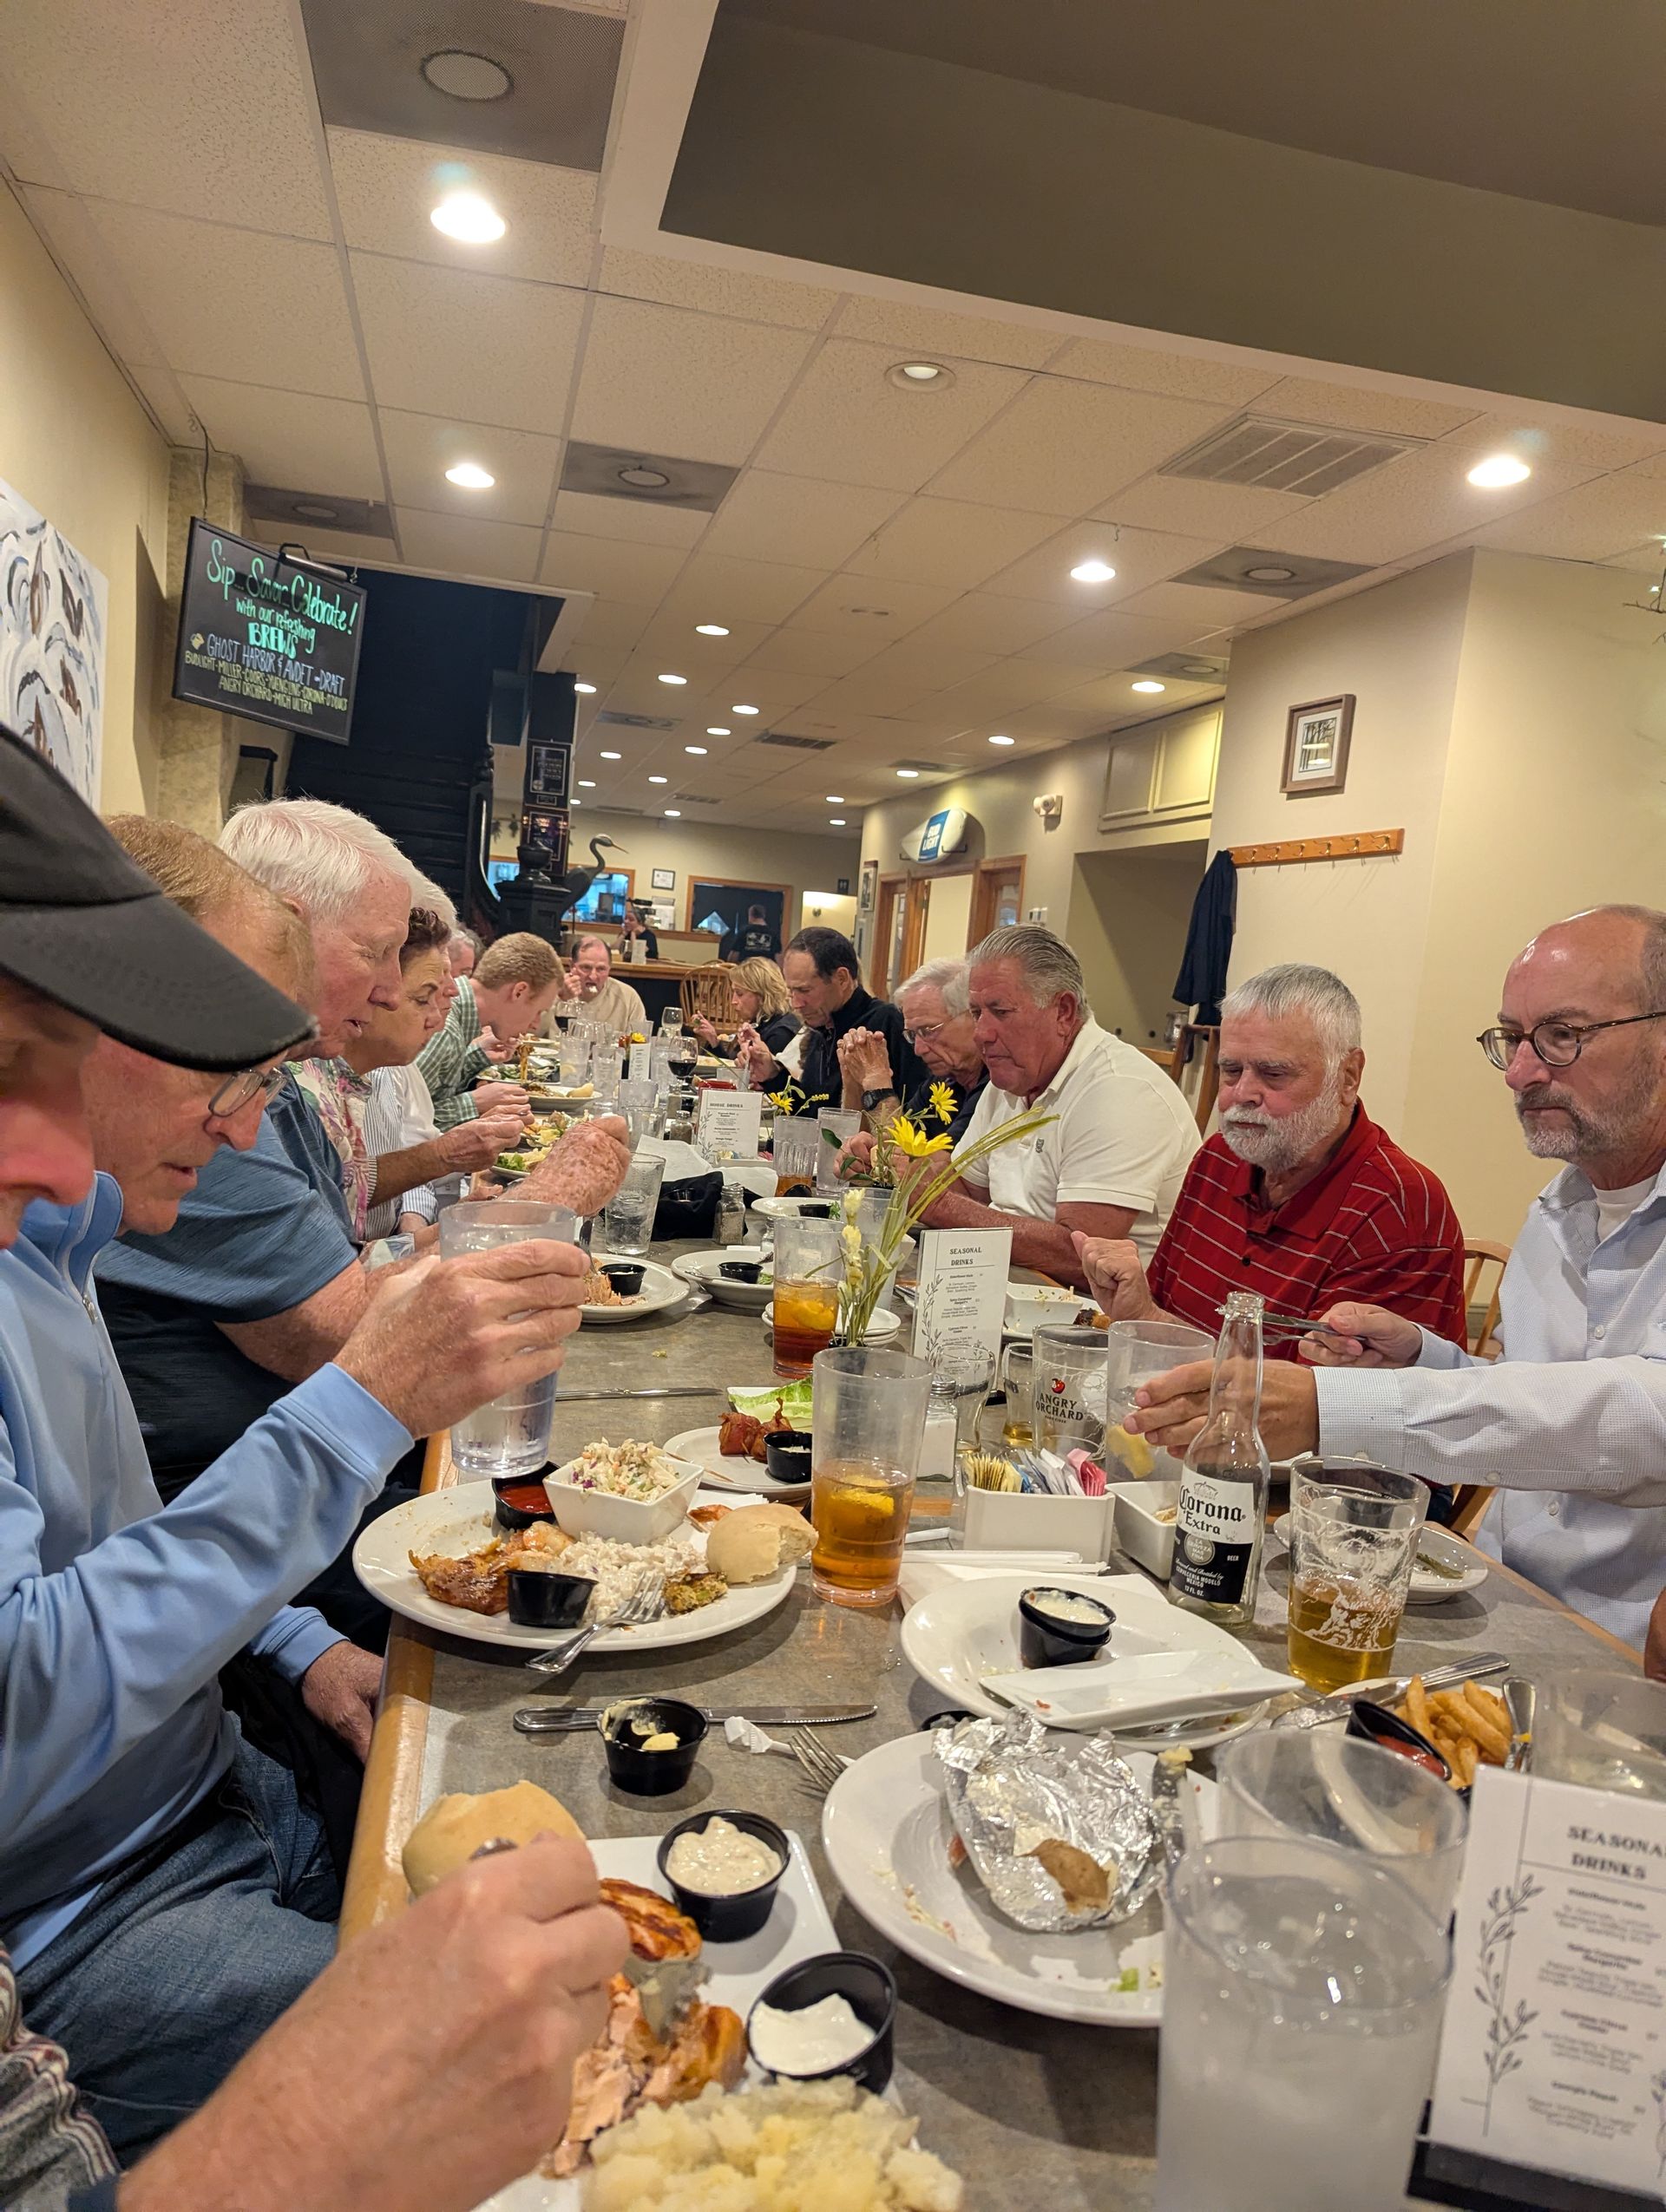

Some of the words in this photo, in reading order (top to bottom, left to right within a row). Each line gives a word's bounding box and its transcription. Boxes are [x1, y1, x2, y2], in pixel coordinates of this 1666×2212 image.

[235, 597, 257, 619] with
[258, 606, 275, 625] our
[291, 574, 358, 636] Celebrate!
[207, 633, 241, 663] GHOST
[242, 645, 276, 673] HARBOR
[247, 621, 299, 659] BREWS
[922, 834, 941, 851] LIGHT
[949, 1247, 982, 1255] SEASONAL
[1035, 1400, 1084, 1421] ORCHARD
[1040, 1392, 1077, 1410] ANGRY
[1179, 1484, 1243, 1522] Corona
[1184, 1510, 1221, 1535] Extra
[1200, 1576, 1221, 1587] MODELO
[1217, 1572, 1224, 1580] by
[1567, 1825, 1666, 1858] SEASONA
[1571, 1853, 1647, 1881] DRINKS
